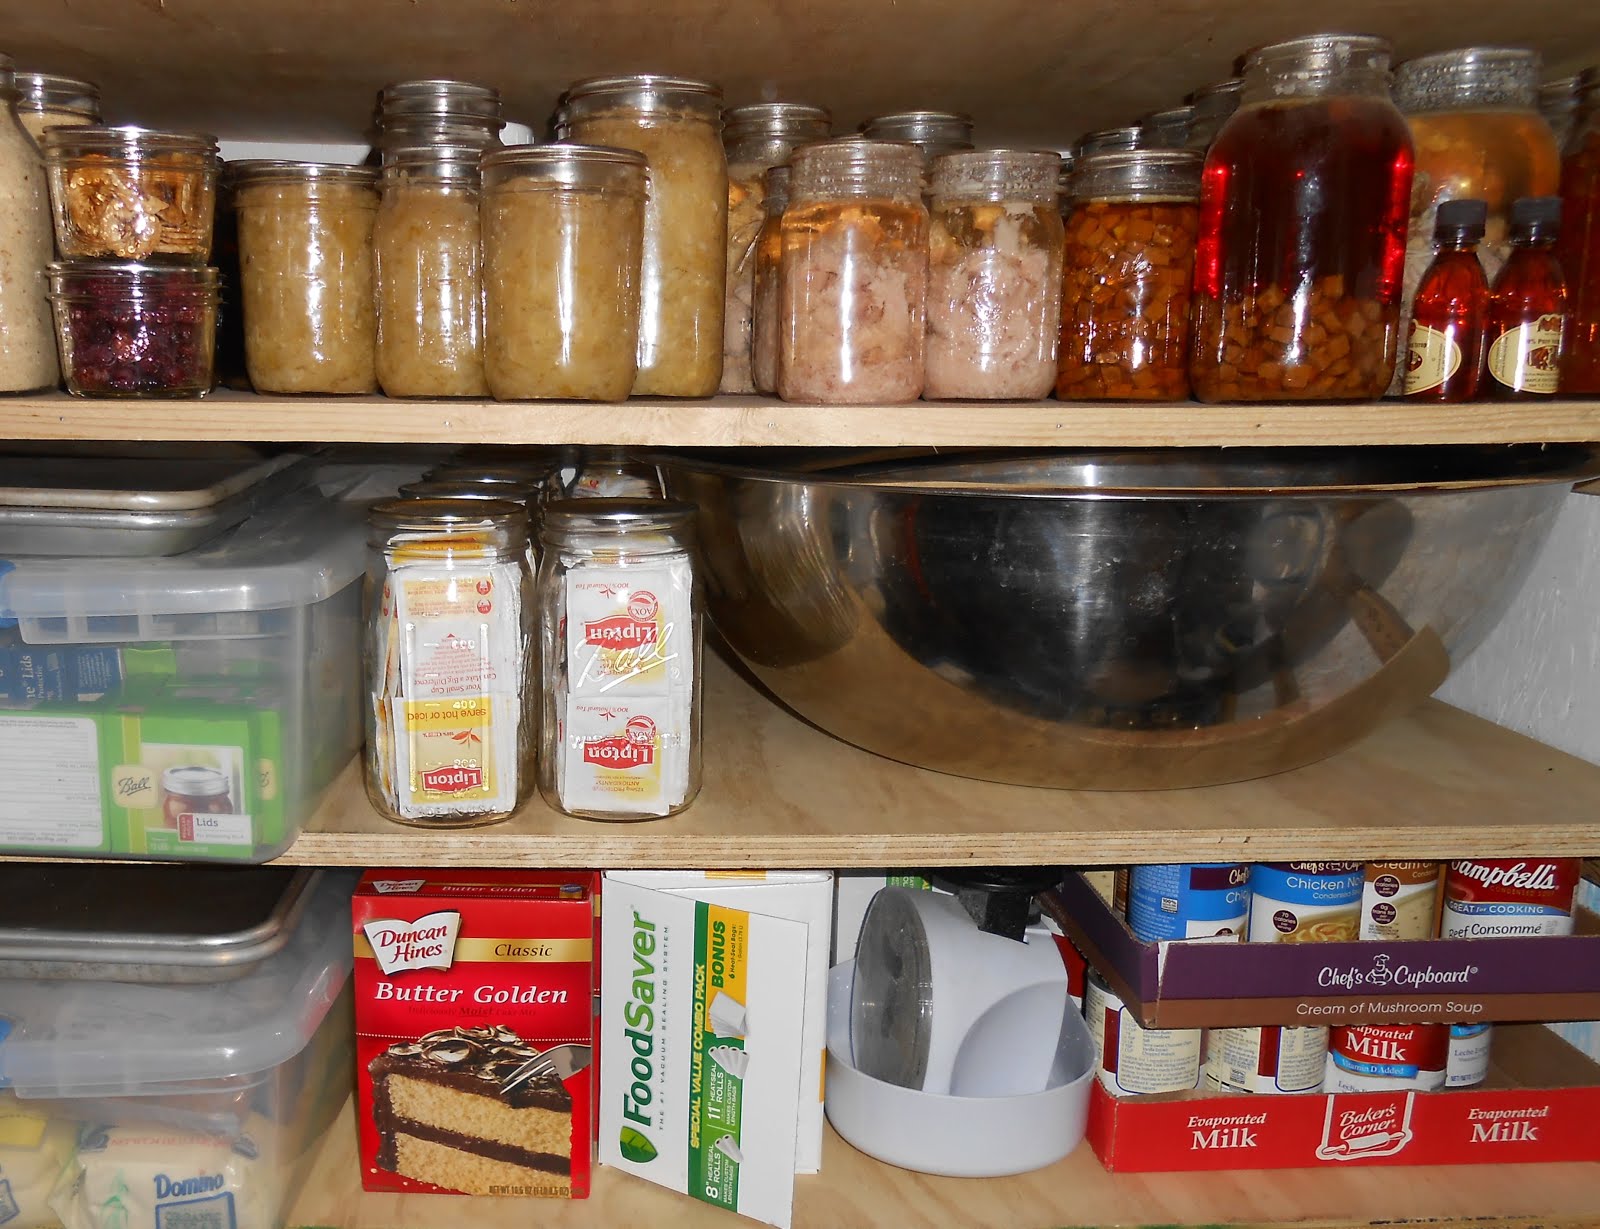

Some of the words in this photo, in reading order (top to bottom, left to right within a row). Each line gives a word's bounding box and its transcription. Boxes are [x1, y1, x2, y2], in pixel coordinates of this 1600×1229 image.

[634, 607, 652, 615] AOX
[590, 623, 653, 642] Lipton
[22, 654, 33, 679] Lids
[430, 685, 445, 694] Cup
[447, 685, 465, 694] Small
[465, 683, 482, 691] Your
[447, 675, 460, 684] Big
[407, 712, 429, 722] iced
[428, 711, 440, 720] or
[442, 709, 458, 719] hot
[460, 708, 487, 718] serve
[588, 743, 649, 763] Lipton
[118, 776, 152, 797] Ball
[427, 770, 479, 786] Lipton
[195, 816, 220, 828] Lids
[1289, 862, 1325, 876] Chefs
[1286, 876, 1346, 891] Chicken
[1475, 905, 1488, 913] for
[1489, 905, 1545, 914] COOKING
[372, 924, 448, 948] Duncan
[1471, 923, 1542, 936] Consommé
[389, 943, 443, 964] Hines
[494, 943, 553, 957] Classic
[712, 920, 726, 988] BONUS
[695, 963, 705, 1000] PACK
[1317, 966, 1363, 988] Chef's
[1394, 964, 1470, 989] Cupboard
[374, 982, 464, 1003] Butter
[473, 985, 569, 1005] Golden
[1296, 1002, 1345, 1015] Cream
[1351, 1002, 1365, 1014] of
[1368, 1002, 1442, 1014] Mushroom
[1446, 1001, 1483, 1015] Soup
[624, 911, 656, 1127] FoodSaver
[693, 1002, 704, 1050] COMBO
[1350, 1024, 1414, 1041] aporated
[1345, 1030, 1406, 1062] Milk
[692, 1051, 703, 1094] VALUE
[1341, 1057, 1371, 1073] Vitamin
[1370, 1065, 1378, 1074] D
[1378, 1065, 1405, 1075] Added
[1186, 1112, 1268, 1129] Evaporated
[1340, 1103, 1397, 1127] Baker's
[1467, 1105, 1550, 1121] Evaporated
[690, 1096, 701, 1149] SPECIAL
[1340, 1117, 1395, 1141] Corner
[1190, 1127, 1259, 1150] Milk
[1469, 1122, 1539, 1144] Milk
[154, 1172, 225, 1200] Domino
[705, 1181, 719, 1199] 8"
